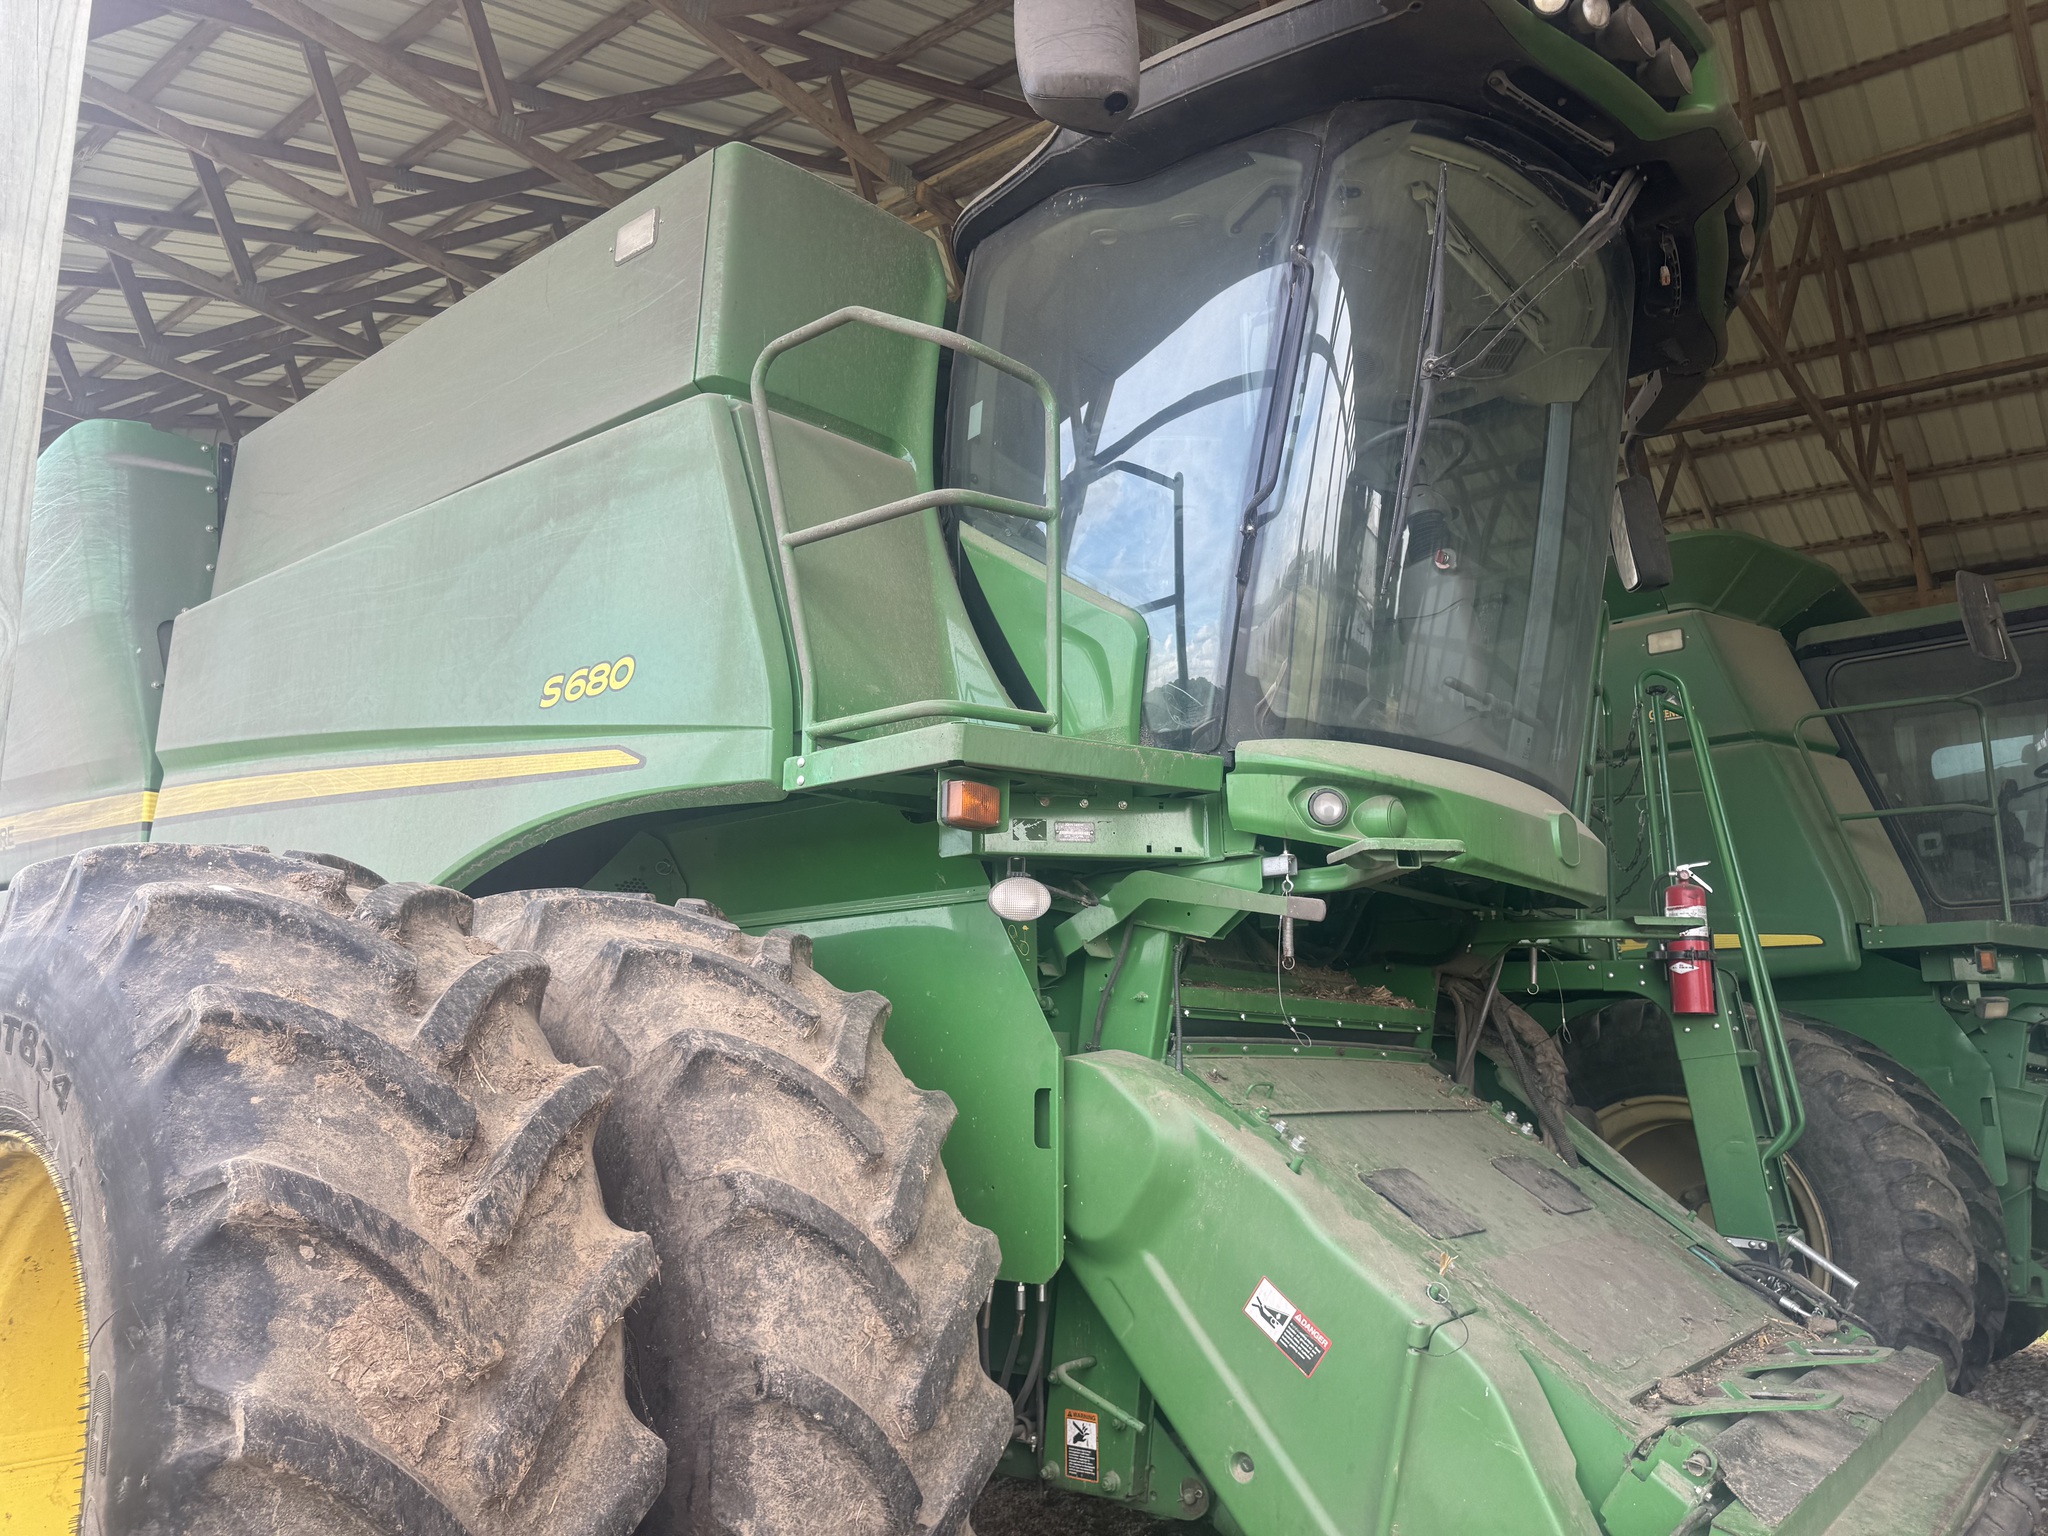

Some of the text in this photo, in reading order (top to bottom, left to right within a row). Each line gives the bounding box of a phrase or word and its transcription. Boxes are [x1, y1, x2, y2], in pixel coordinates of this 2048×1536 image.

[539, 654, 636, 709] S680
[1300, 1318, 1329, 1348] DANGER
[1073, 1412, 1096, 1421] WARNING
